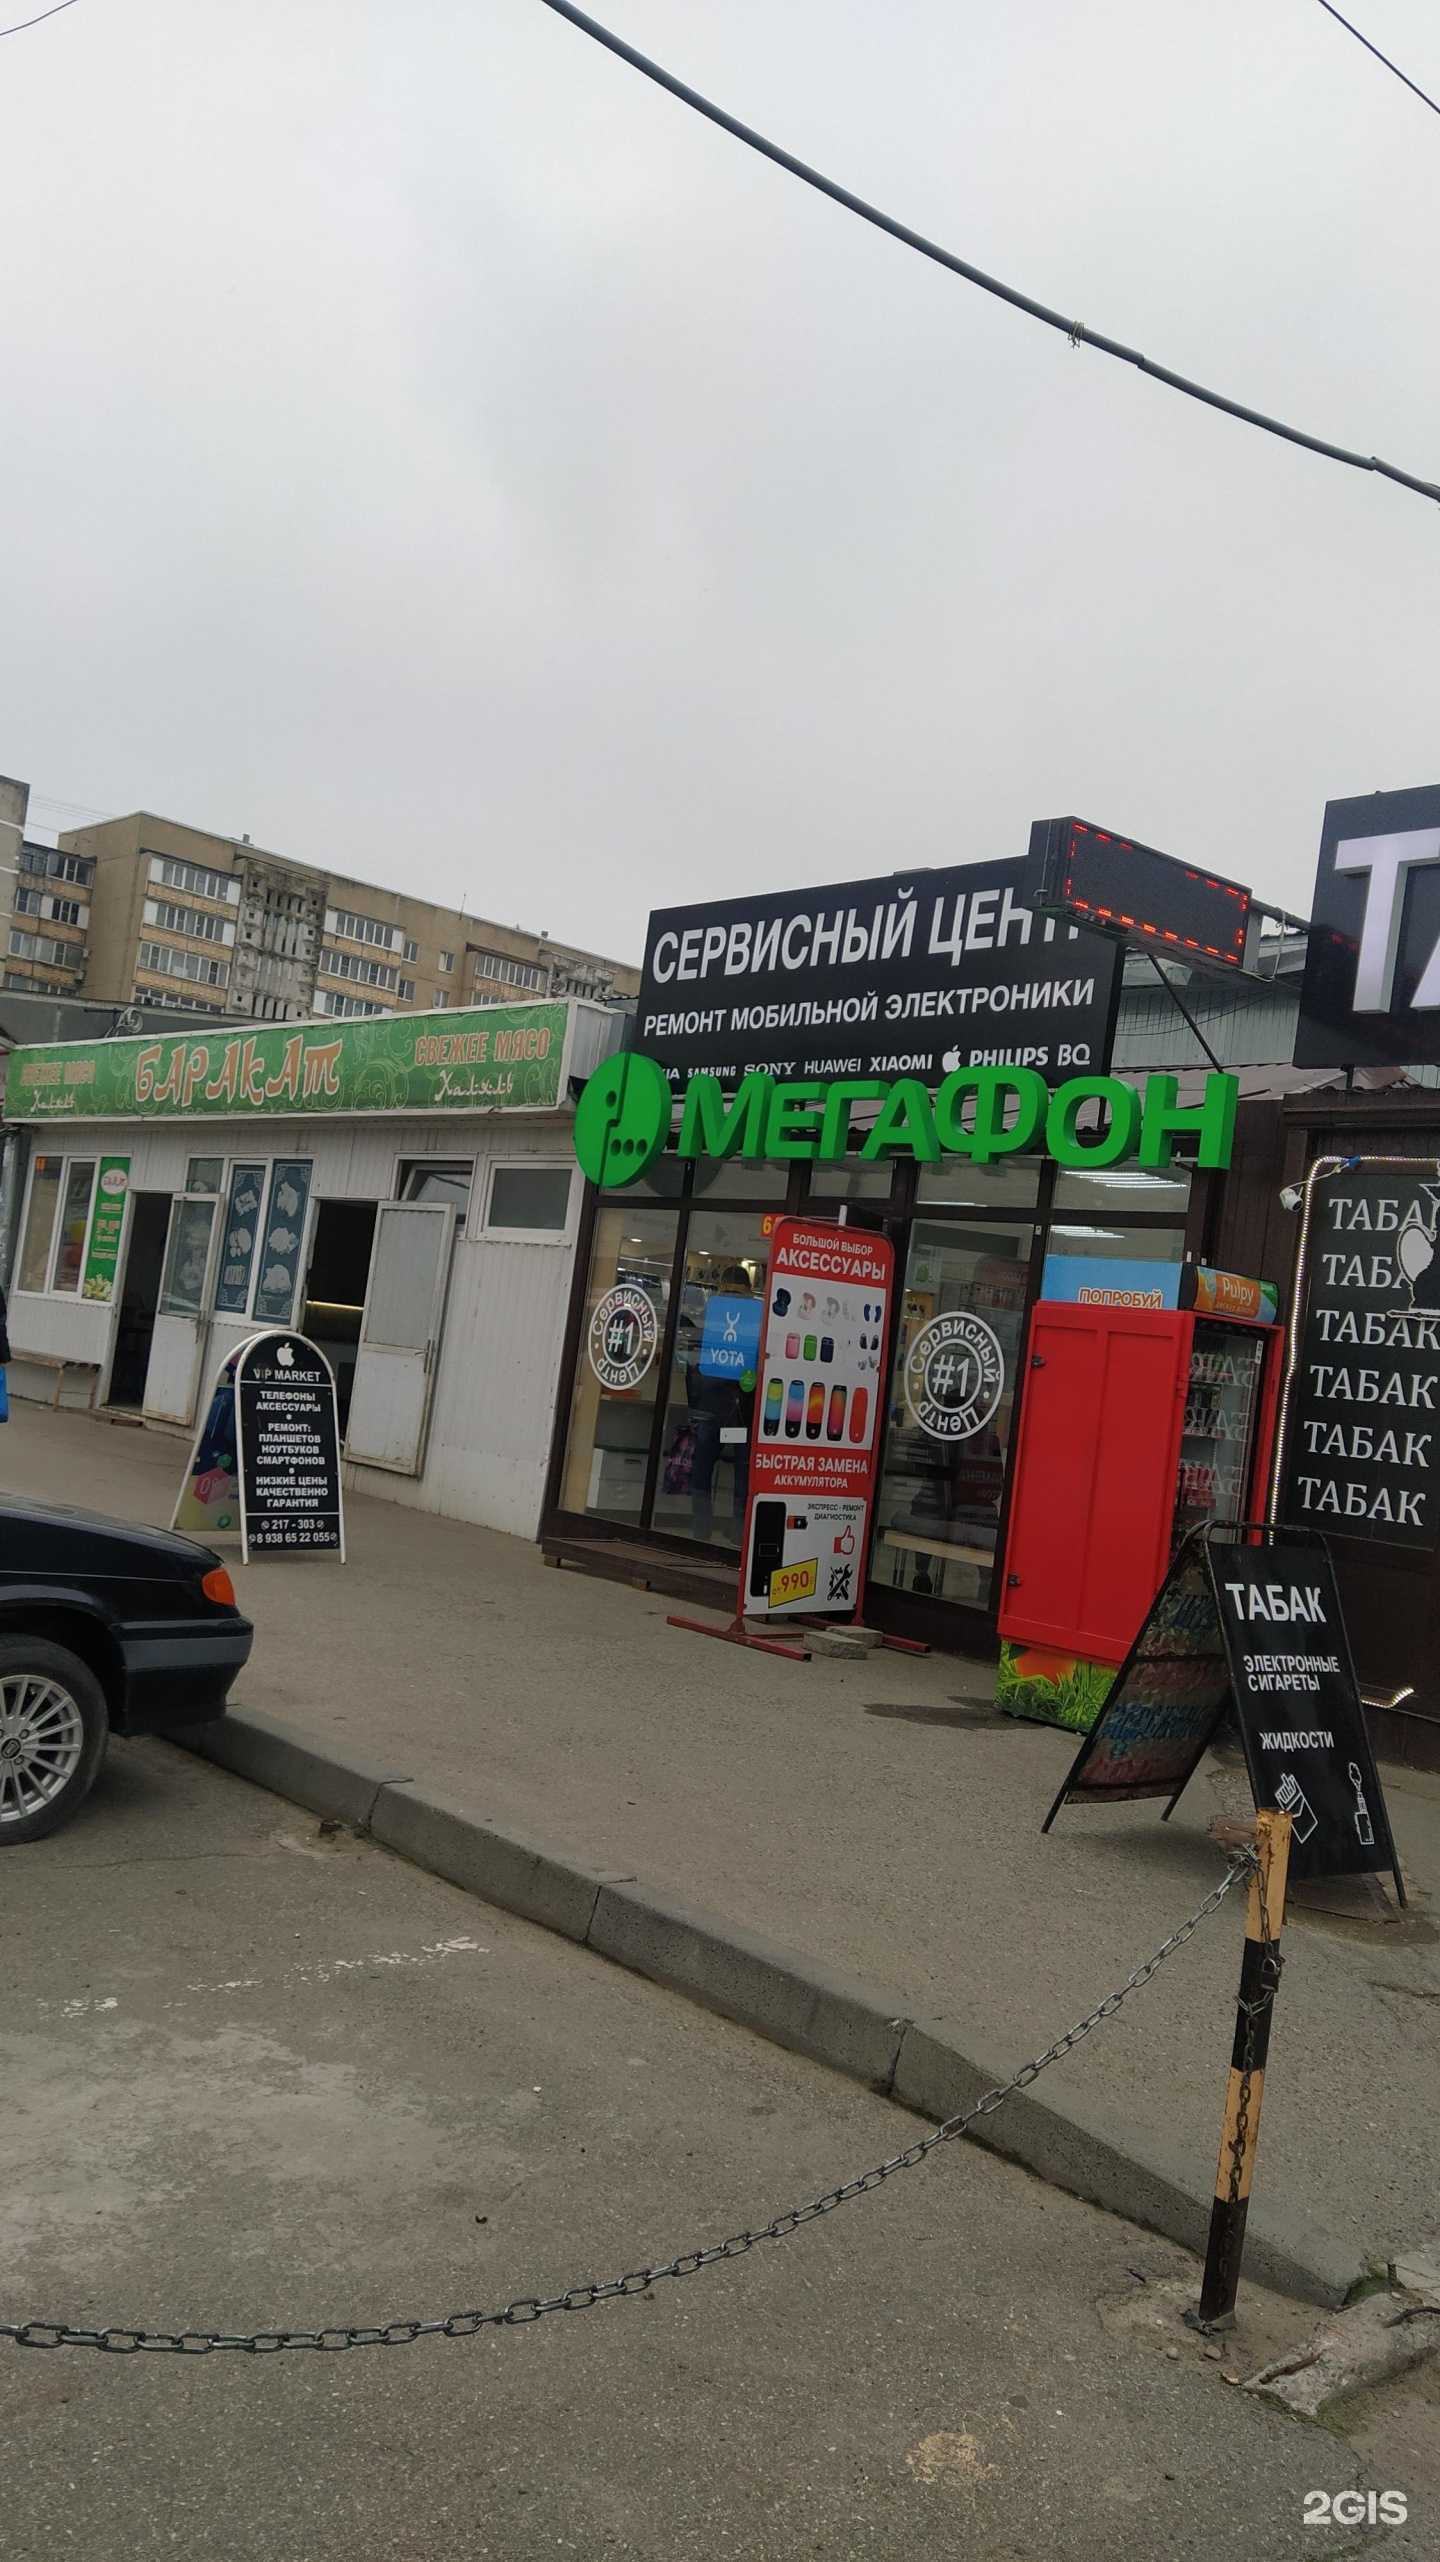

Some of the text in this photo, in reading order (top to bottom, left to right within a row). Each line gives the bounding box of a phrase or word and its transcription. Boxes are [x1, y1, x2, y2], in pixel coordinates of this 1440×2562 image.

[652, 886, 1079, 984] СЕРВИСНЫЙ ЦЕН
[644, 978, 1096, 1036] РЕМОНТ МОБИЛЬНОЙ ЭЛЕКТРОНИКИ
[414, 1027, 551, 1066] СВЕЖЕЕ МЯСО
[687, 1066, 737, 1078] SAMSUNG
[743, 1062, 796, 1077] SONY
[804, 1058, 862, 1074] HUAWEI
[868, 1054, 933, 1072] XIAOMI
[969, 1046, 1049, 1067] PHILIPS
[1057, 1043, 1091, 1066] BQ
[677, 1066, 1240, 1170] МЕГАФОН
[792, 1233, 873, 1256] БОЛЬШОЙ ВЫБОР
[776, 1247, 886, 1280] АКСЕССУАРЫ
[1079, 1286, 1163, 1309] ПОПРОБУЙ
[1222, 1277, 1255, 1306] Pulpy
[592, 1290, 656, 1343] Сервисный
[607, 1319, 634, 1355] #1
[1316, 1309, 1440, 1350] ТАБАК
[710, 1349, 745, 1366] YOTA
[910, 1319, 1002, 1384] Сервисный
[253, 1368, 321, 1382] VIP MARKET
[932, 1354, 969, 1398] #1
[260, 1390, 316, 1401] ТЕЛЕФОНЫ
[1310, 1365, 1439, 1409] ТАБАК
[256, 1402, 321, 1412] АКСЕССУАРЫ
[918, 1401, 980, 1432] Центр
[259, 1434, 321, 1443] ПЛАНШЕТОВ
[268, 1423, 311, 1432] РЕМОНТ:
[261, 1445, 319, 1454] НОУТБУКОВ
[1303, 1420, 1432, 1468] ТАБАК
[256, 1456, 325, 1465] СМАРТФОНОВ
[755, 1453, 868, 1474] БЫСТРАЯ ЗАМЕНА
[256, 1476, 328, 1486] НИЗКИЕ ЦЕНЫ
[256, 1487, 328, 1496] КАЧЕСТВЕННО
[774, 1474, 848, 1488] АККУМУЛЯТОРА
[266, 1499, 319, 1508] ГАРАНТИЯ
[1297, 1476, 1426, 1527] ТАБАК
[272, 1519, 289, 1530] 217
[298, 1519, 315, 1529] 303
[780, 1570, 810, 1593] 990
[1225, 1583, 1327, 1622] ТАБАК
[1243, 1654, 1340, 1673] ЭЛЕКТРОННЫЕ
[1247, 1674, 1321, 1691] СИГАРЕТЫ
[1259, 1731, 1335, 1752] ЖИДКОСТИ
